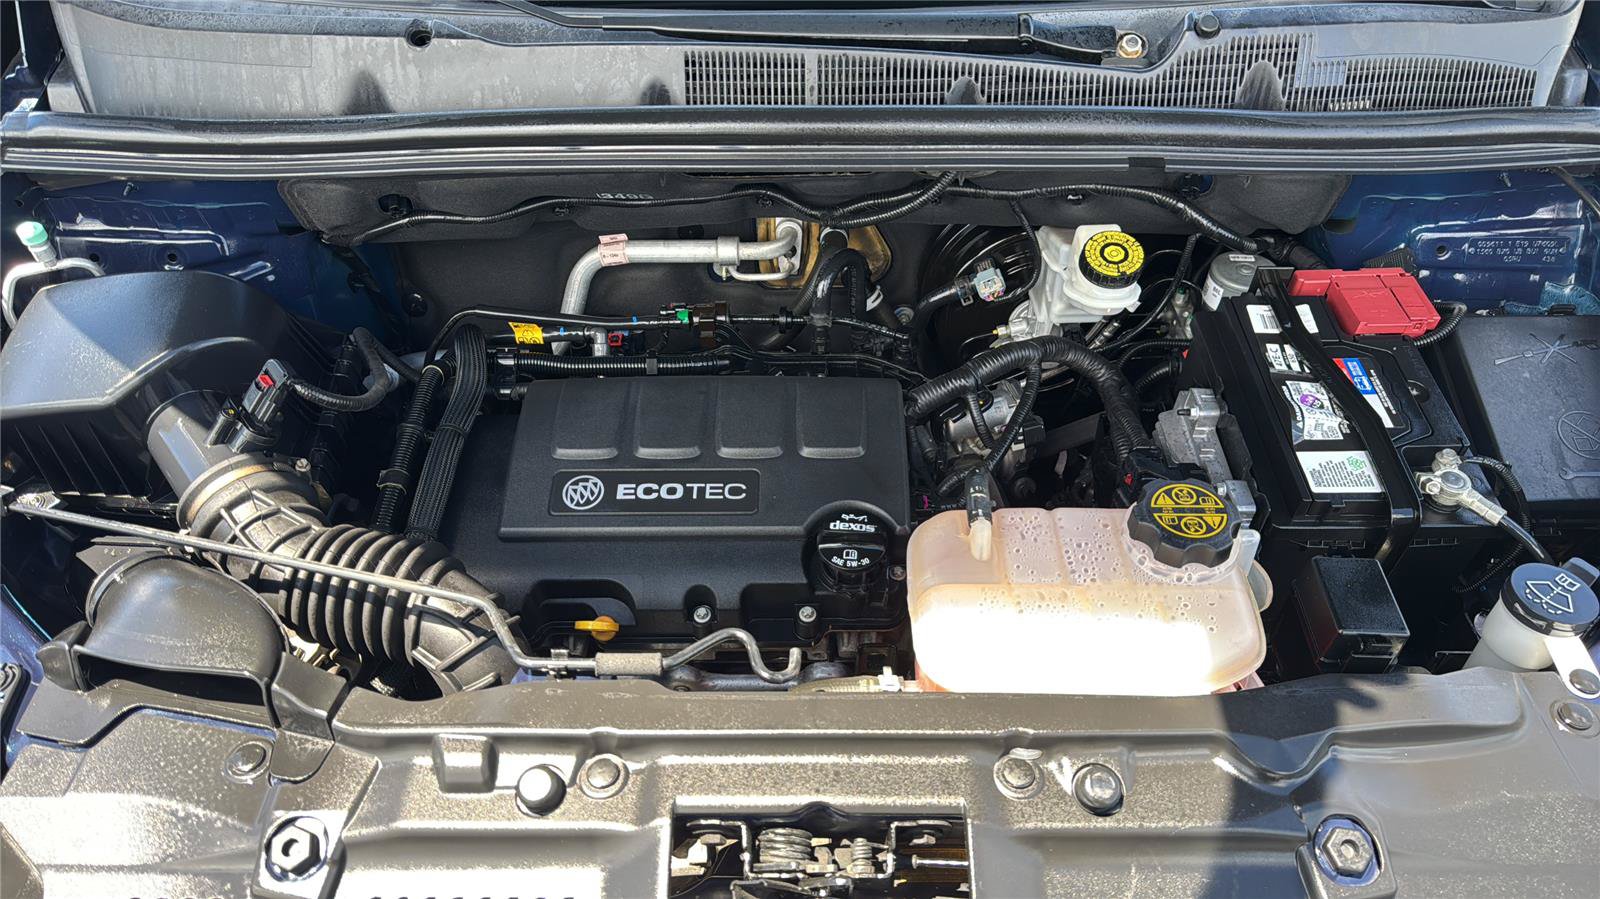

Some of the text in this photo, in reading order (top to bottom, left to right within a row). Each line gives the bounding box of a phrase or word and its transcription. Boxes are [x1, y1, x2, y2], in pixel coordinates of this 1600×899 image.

[616, 483, 747, 500] ECOTEC
[829, 520, 875, 533] dexos
[831, 556, 870, 567] SAE 5W-30
